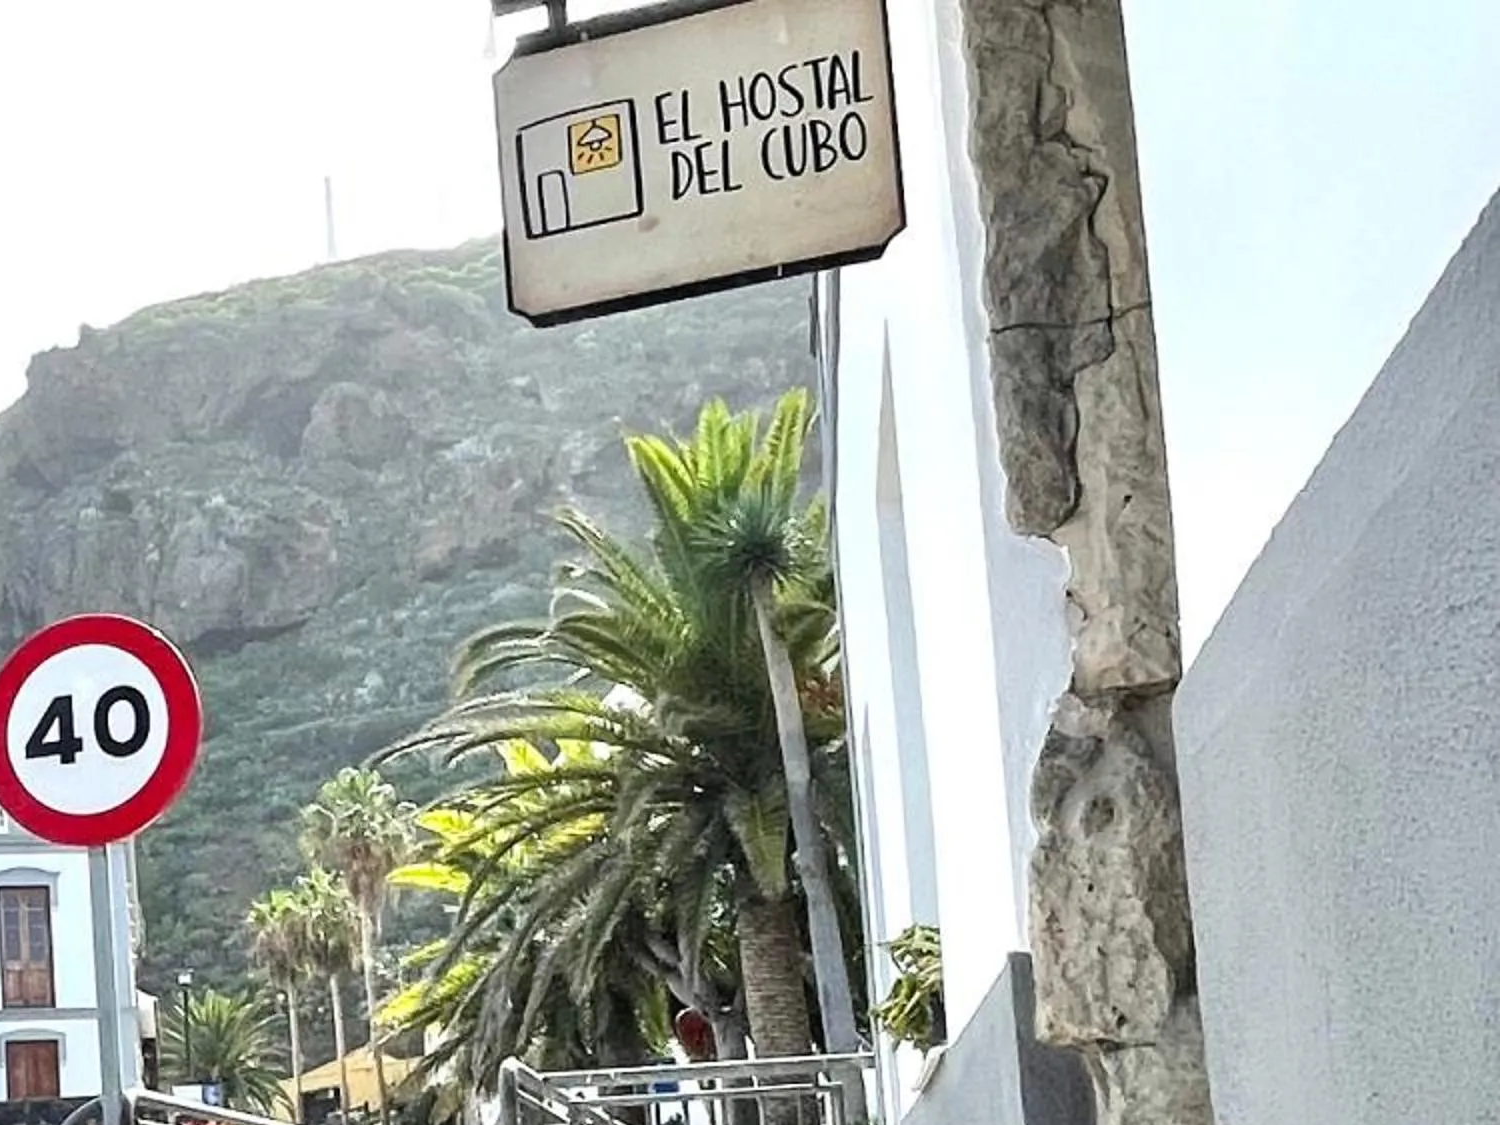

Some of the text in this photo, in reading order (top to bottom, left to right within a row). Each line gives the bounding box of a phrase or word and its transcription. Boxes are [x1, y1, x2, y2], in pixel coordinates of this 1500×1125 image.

[654, 50, 874, 145] EL HOSTAL
[671, 111, 867, 201] DEL CUBO
[25, 685, 151, 764] 40
